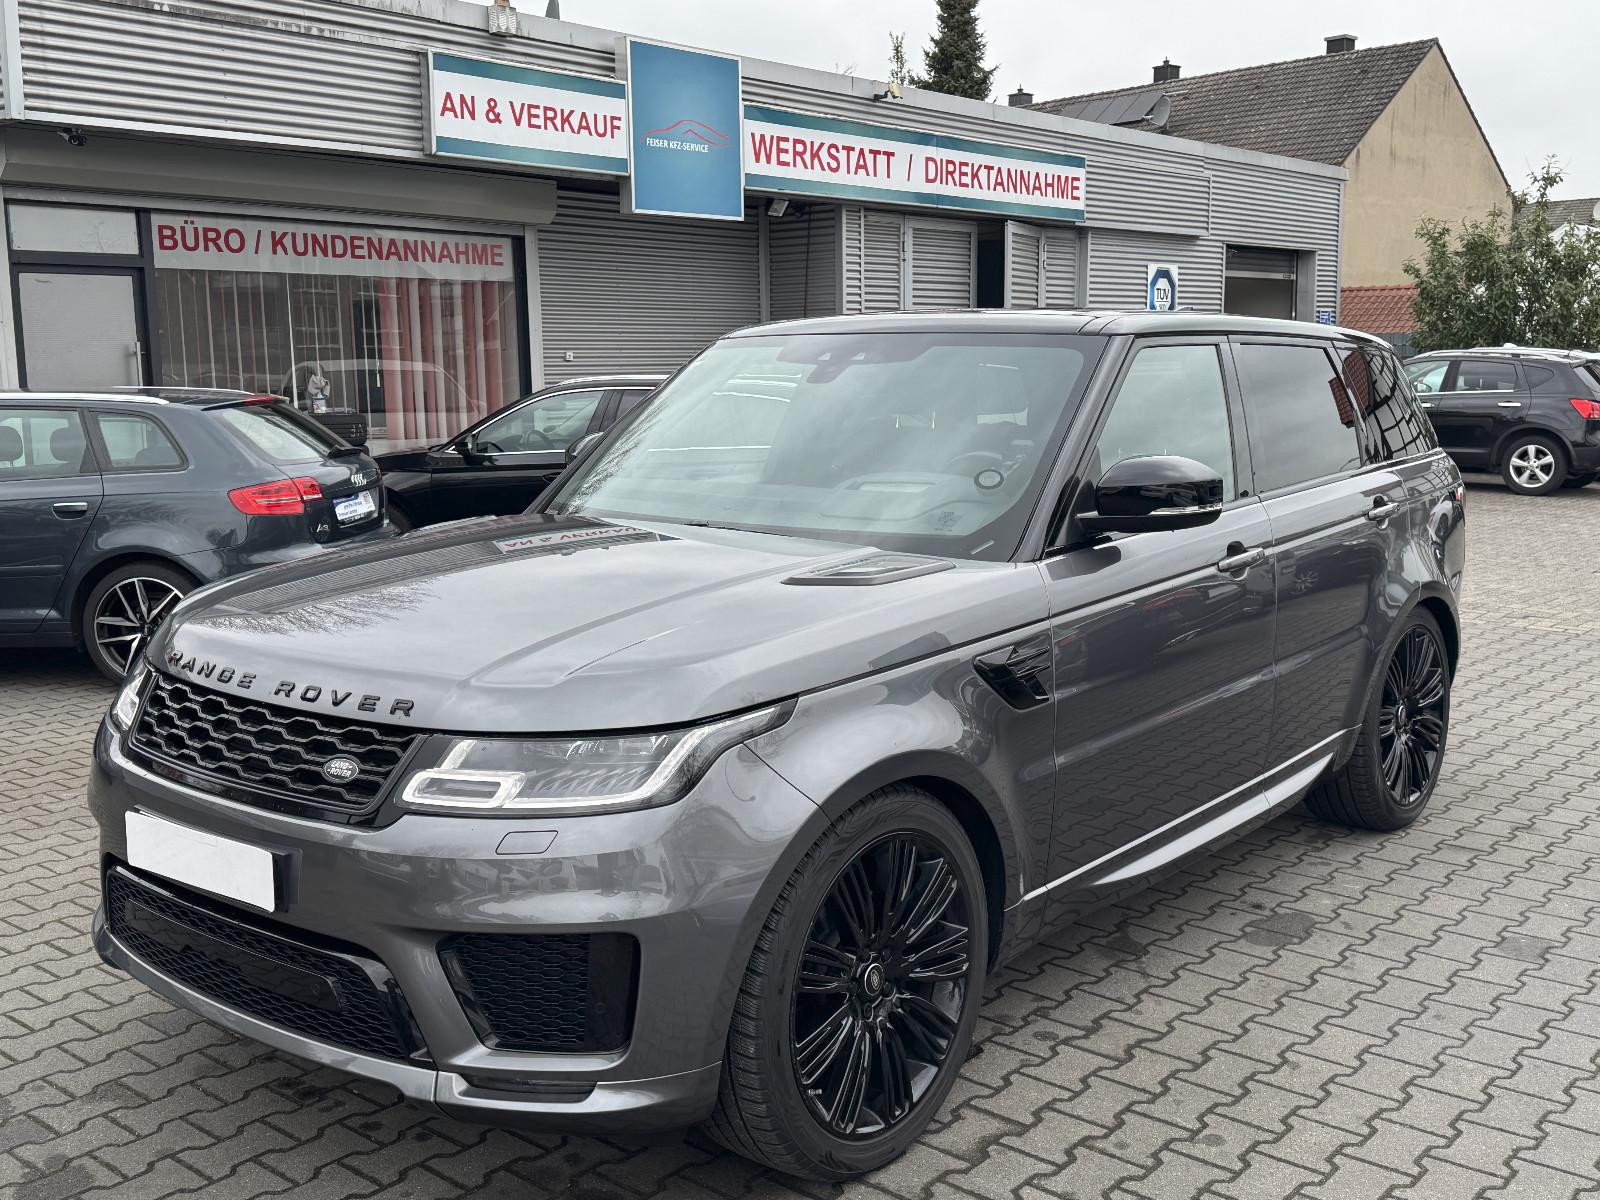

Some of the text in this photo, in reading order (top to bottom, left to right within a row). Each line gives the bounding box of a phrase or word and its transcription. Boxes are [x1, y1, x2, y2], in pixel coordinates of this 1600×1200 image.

[440, 91, 622, 139] AN & VERKAUF
[646, 137, 709, 153] FEISER KFZ-SERVICE
[751, 132, 1081, 201] WERKSTATT / DIREKTANNAHME
[157, 220, 503, 266] BÜRO / KUNDENANNAHME
[167, 649, 415, 717] RANGE ROVER
